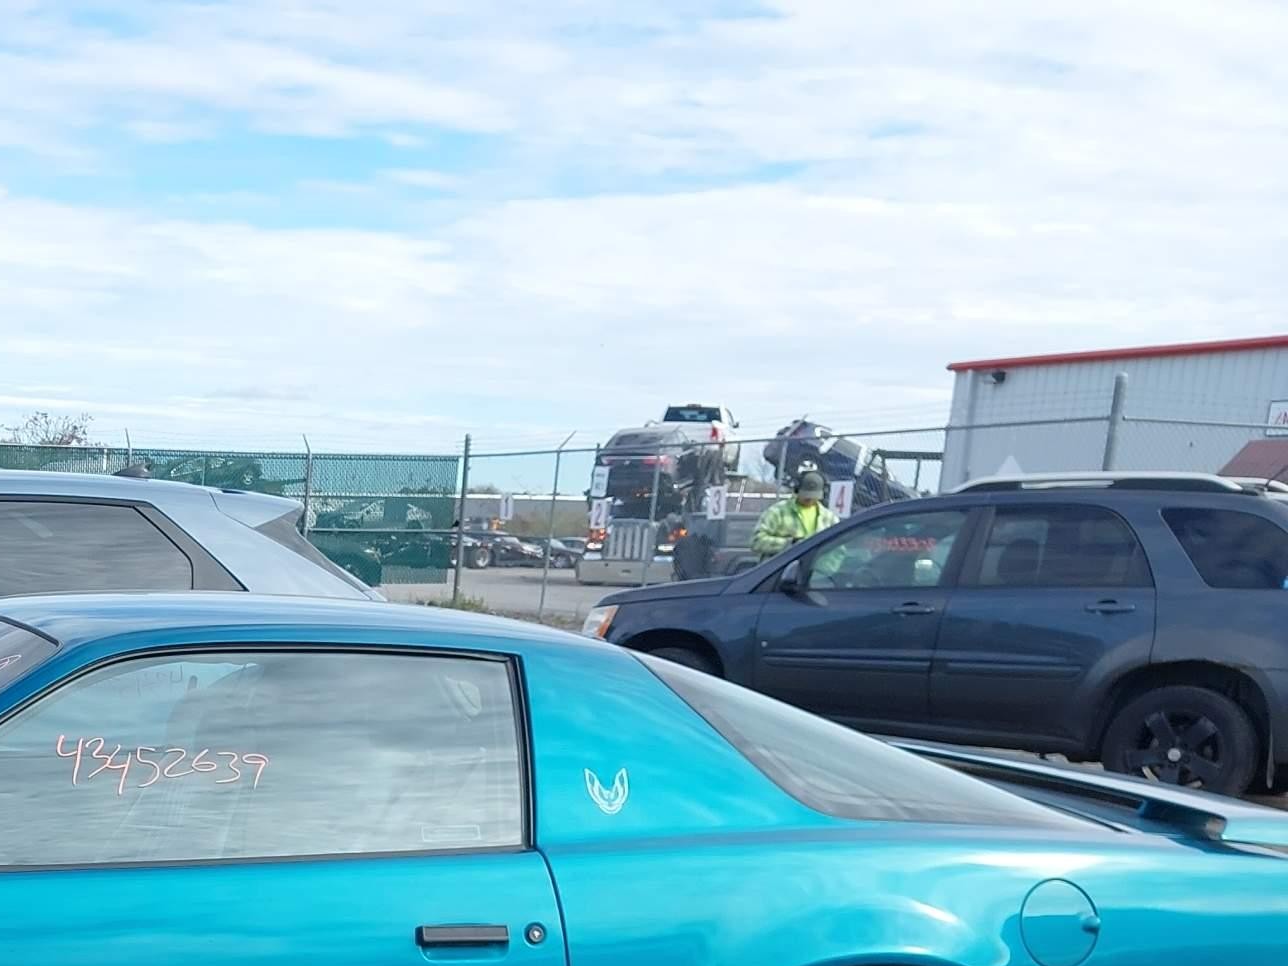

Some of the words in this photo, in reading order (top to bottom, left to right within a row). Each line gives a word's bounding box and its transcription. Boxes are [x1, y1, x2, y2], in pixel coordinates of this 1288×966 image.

[712, 489, 722, 516] 3
[834, 484, 846, 514] 4
[56, 734, 269, 795] 43452639
